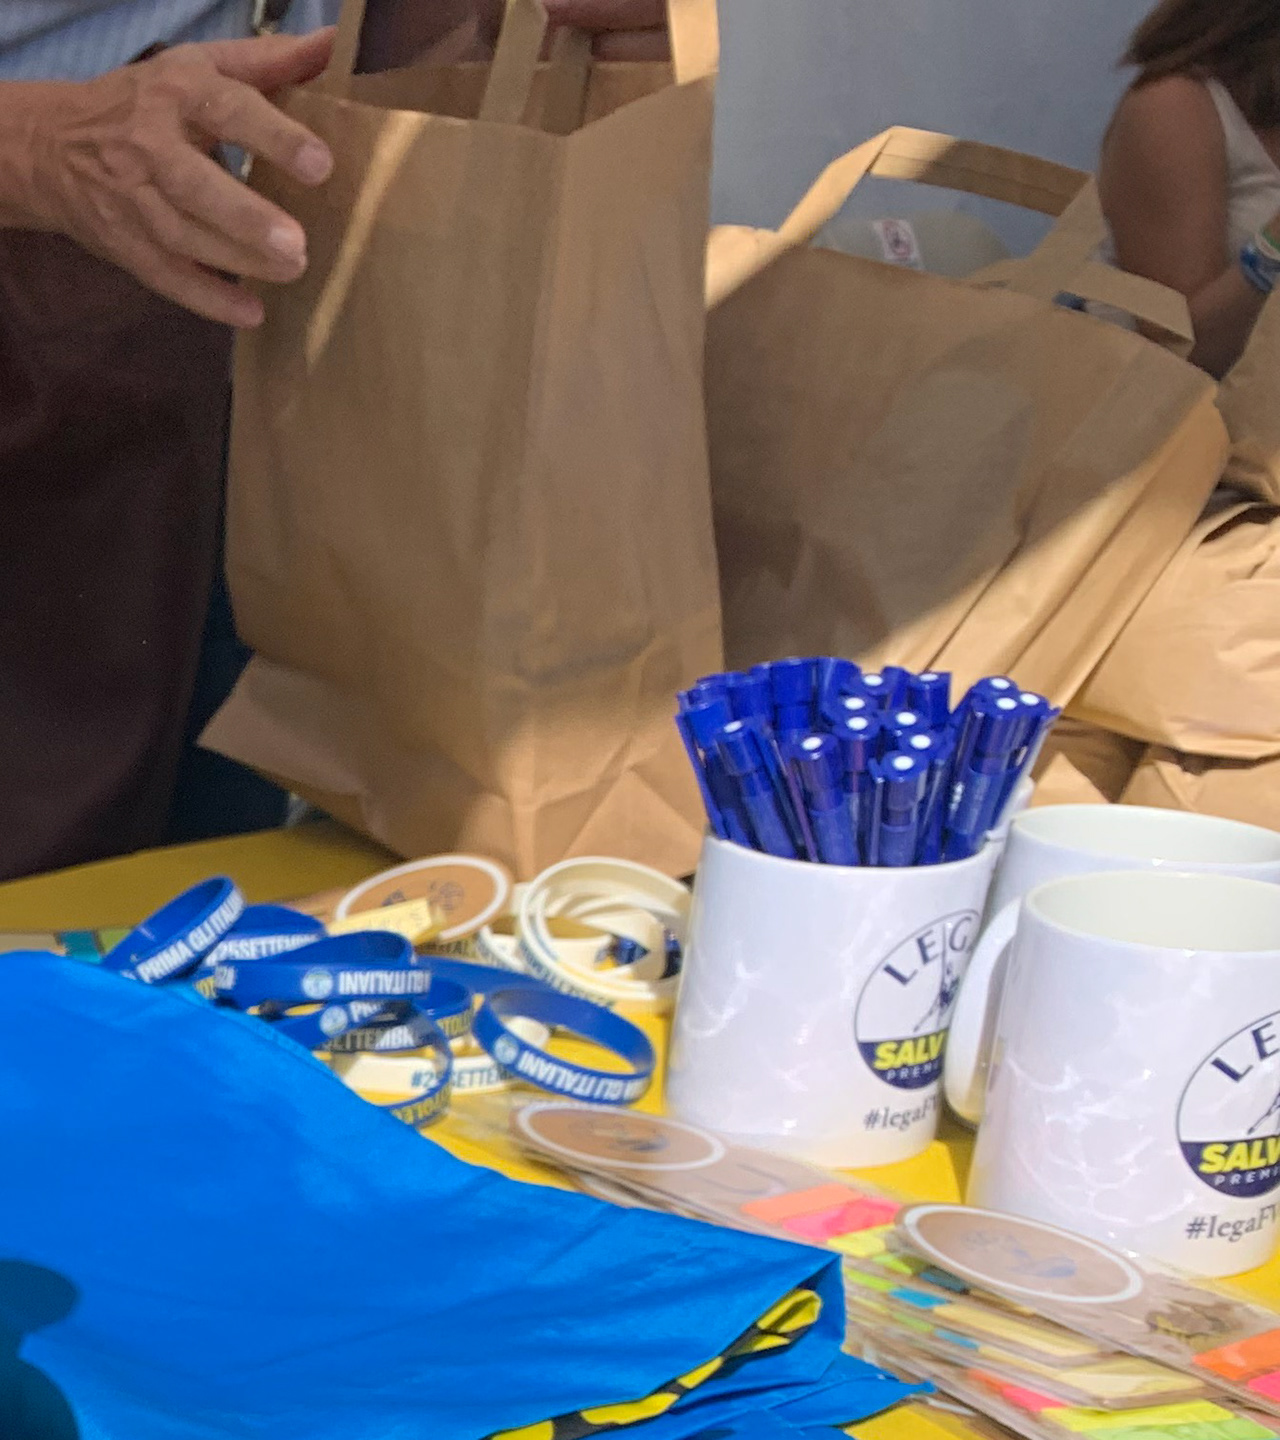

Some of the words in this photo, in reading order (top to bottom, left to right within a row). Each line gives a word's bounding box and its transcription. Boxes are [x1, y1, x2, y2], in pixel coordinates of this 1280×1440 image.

[883, 915, 974, 987] LEG
[339, 970, 407, 996] ITALIANI
[516, 1050, 597, 1100] ITALIANI
